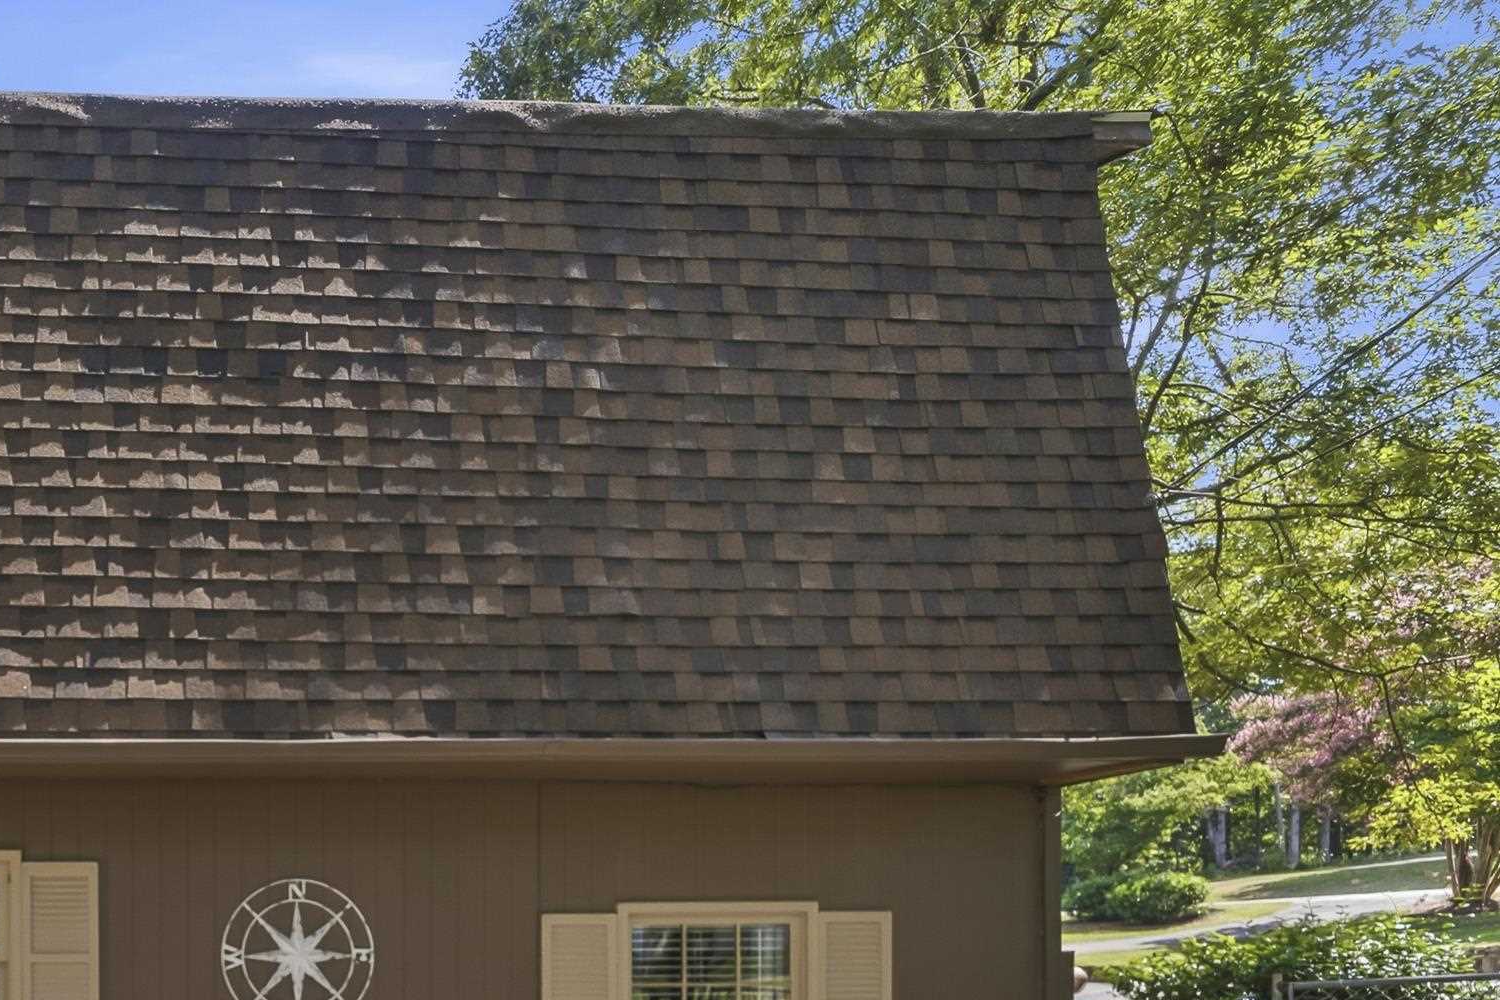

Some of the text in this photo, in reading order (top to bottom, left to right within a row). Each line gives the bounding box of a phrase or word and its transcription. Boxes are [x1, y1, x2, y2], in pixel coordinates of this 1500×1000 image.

[288, 880, 307, 901] N
[222, 944, 245, 970] W
[352, 948, 373, 964] E
